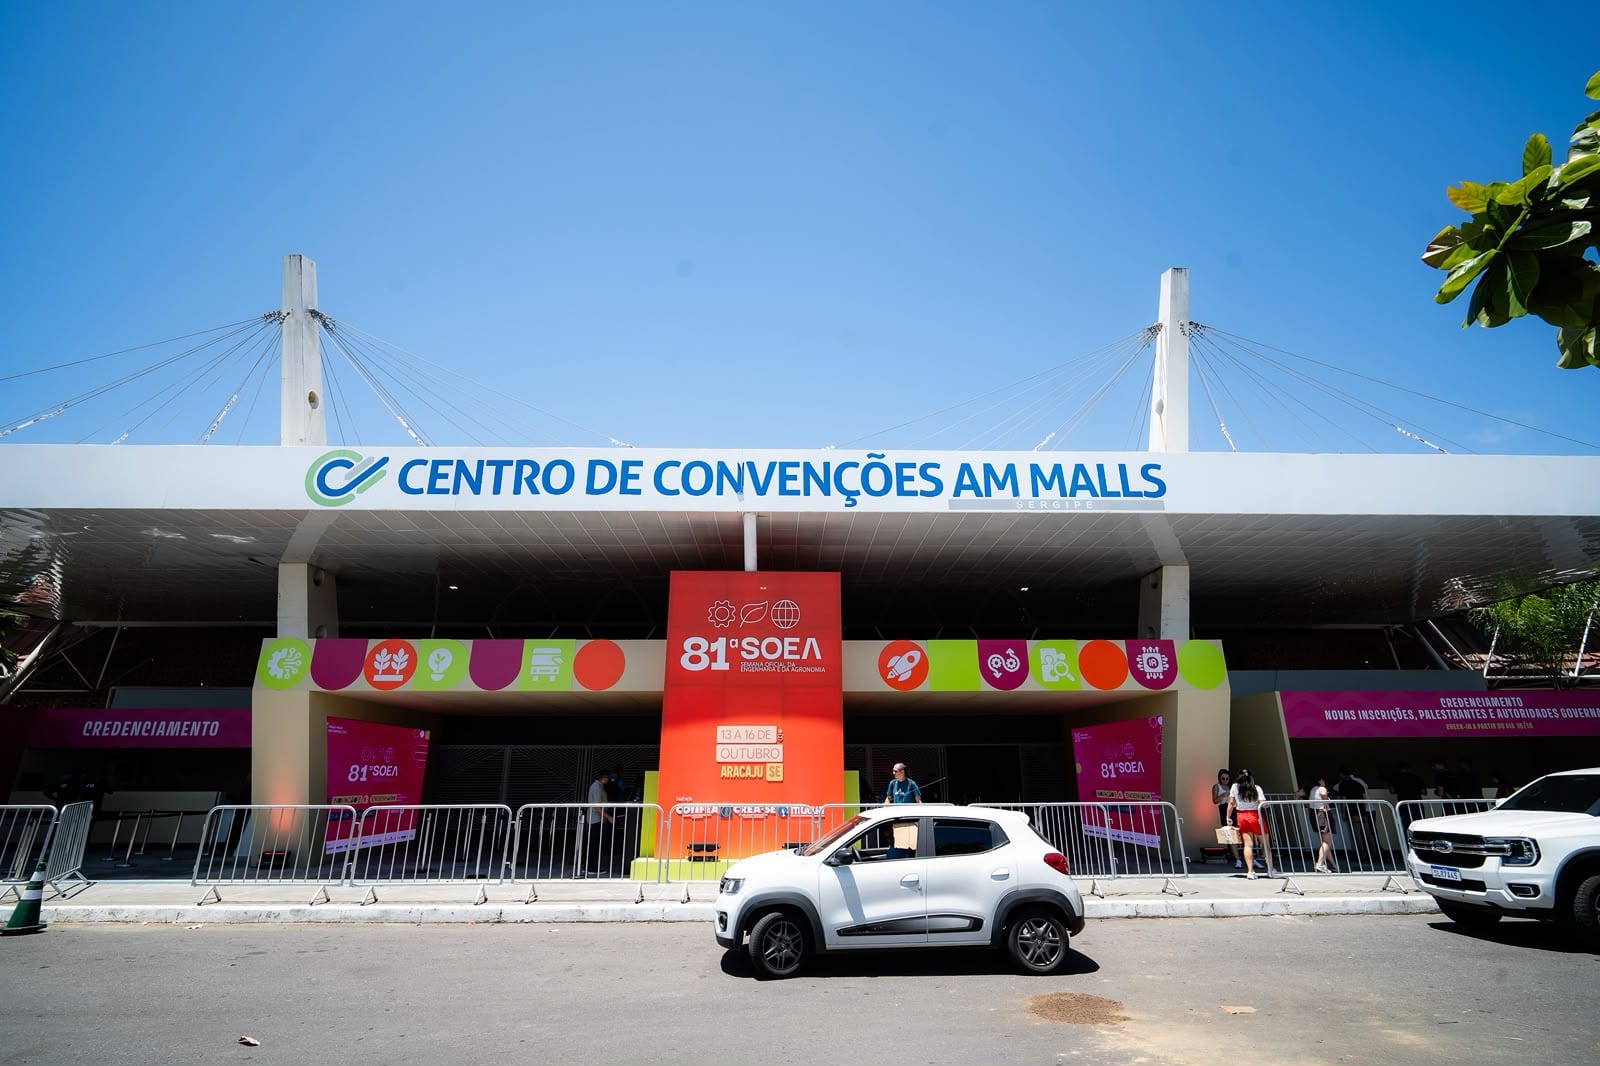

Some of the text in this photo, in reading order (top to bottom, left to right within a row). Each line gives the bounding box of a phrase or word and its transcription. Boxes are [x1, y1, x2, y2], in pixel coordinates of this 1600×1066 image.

[397, 453, 1168, 507] CENTRO DE CONVENÇÕES AM MALLS
[1016, 500, 1094, 510] SERGIPE
[1439, 697, 1524, 708] CREDENCIAMENTO
[1324, 709, 1357, 721] NOVAS
[1358, 707, 1418, 722] INSCRIÇÕES,
[1418, 709, 1487, 720] PALESTRANTES
[1489, 708, 1496, 719] E
[1497, 708, 1560, 719] AUTORIDADES
[82, 720, 220, 737] CREDENCIAMENTO
[721, 729, 732, 740] 13
[734, 729, 742, 740] A
[744, 729, 755, 740] 16
[757, 729, 772, 740] DE
[720, 747, 780, 760] OUTUBRO
[720, 765, 781, 778] ARACAJU SE
